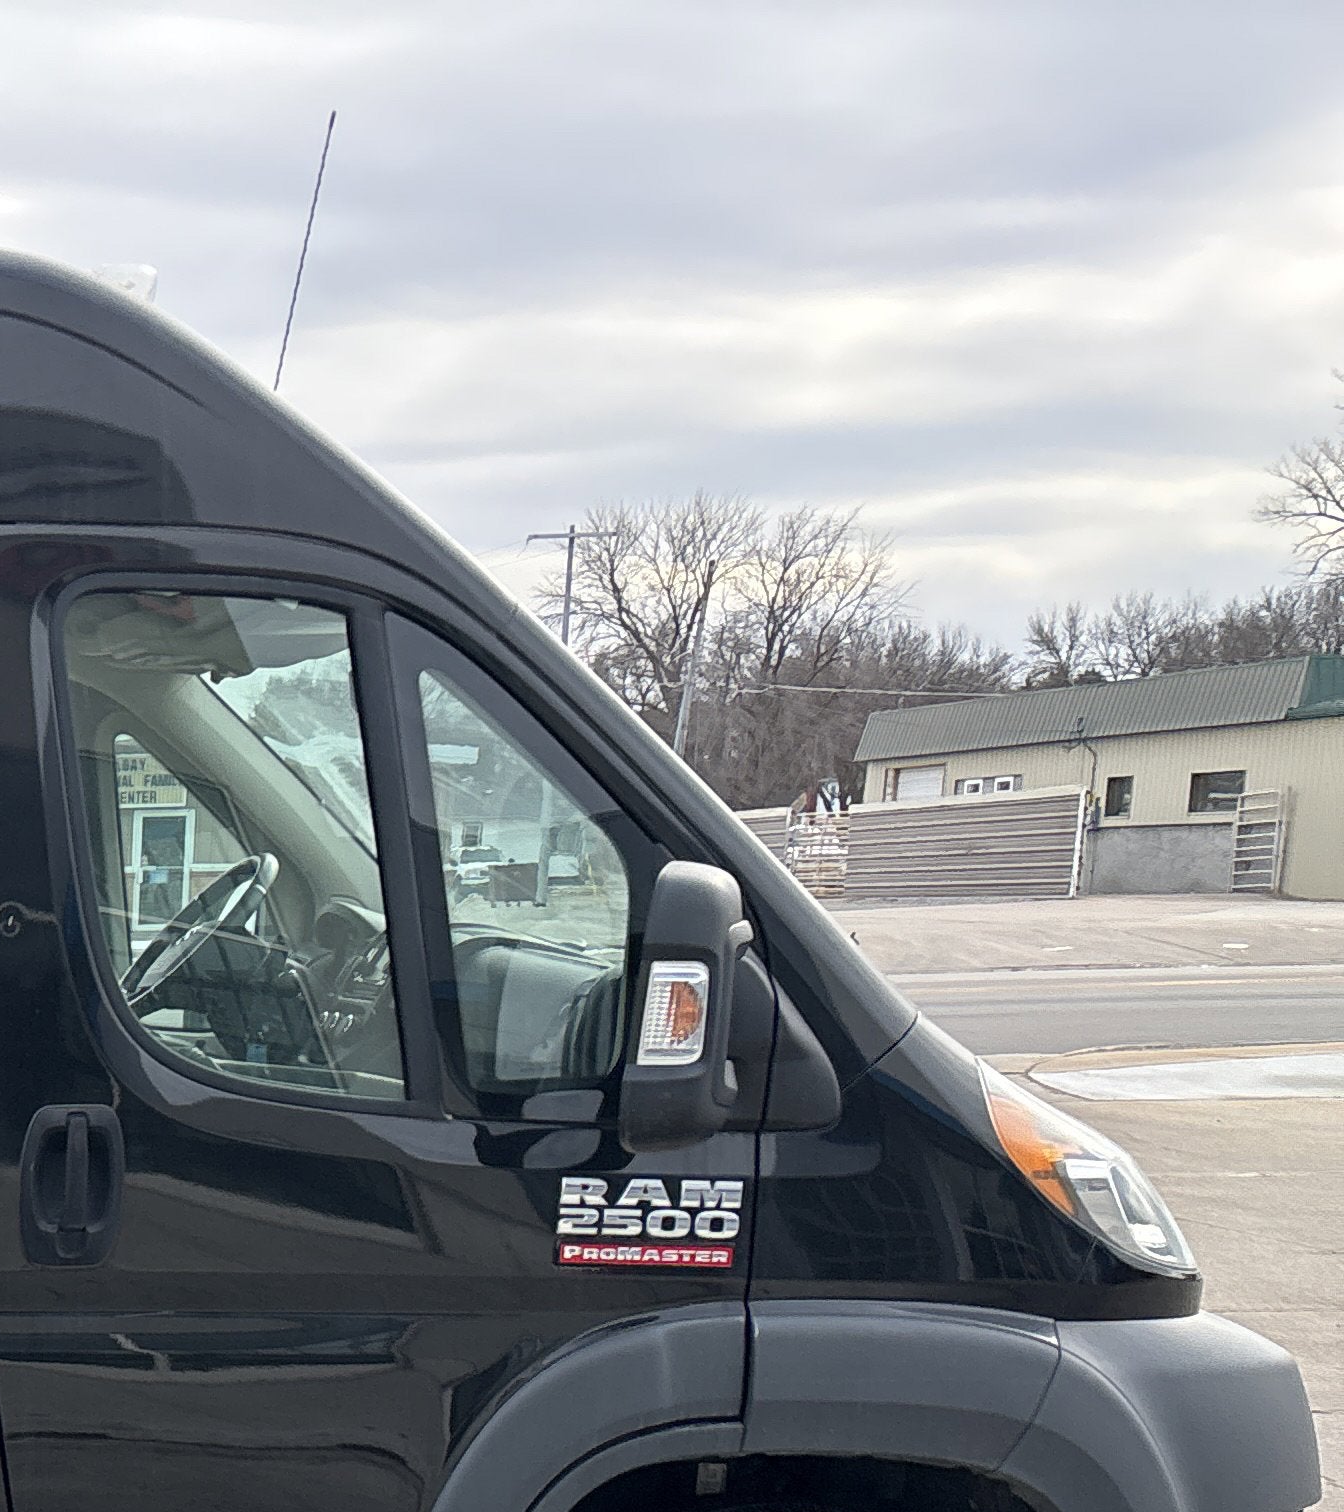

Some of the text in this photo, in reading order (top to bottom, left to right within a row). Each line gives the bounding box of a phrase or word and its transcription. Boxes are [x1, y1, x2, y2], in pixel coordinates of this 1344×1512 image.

[119, 790, 157, 804] ENTER
[559, 1176, 744, 1208] RAM
[556, 1207, 740, 1239] 2500
